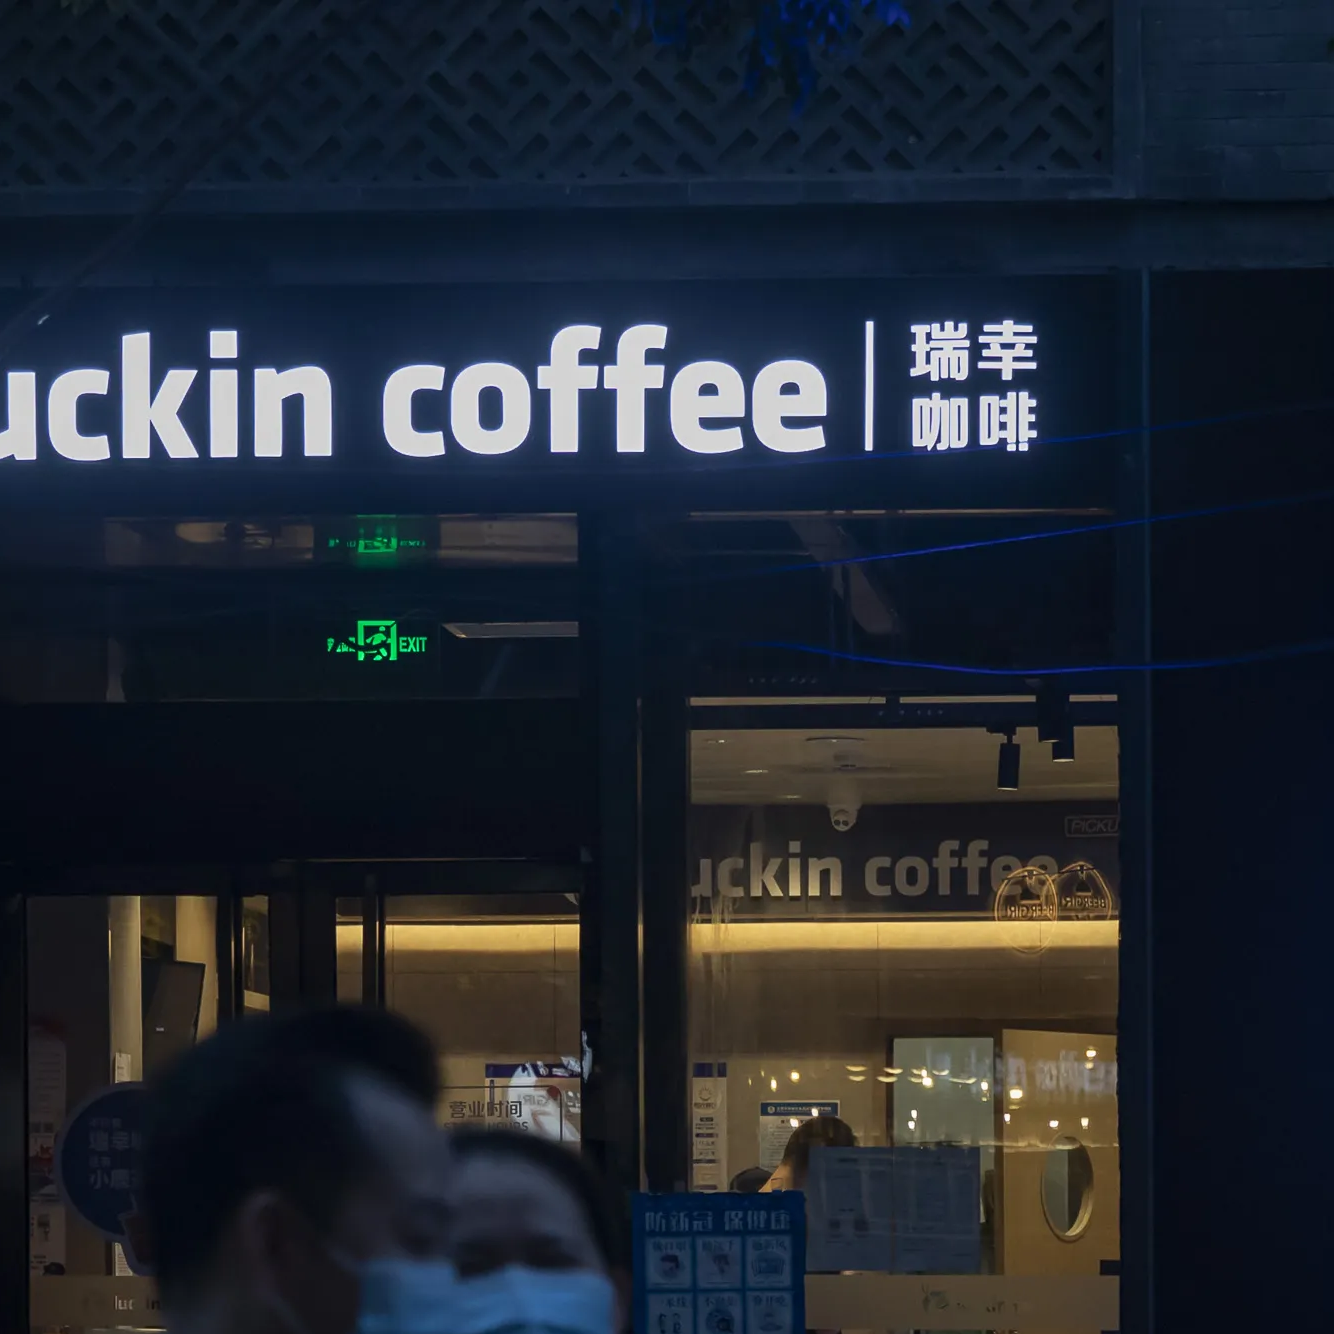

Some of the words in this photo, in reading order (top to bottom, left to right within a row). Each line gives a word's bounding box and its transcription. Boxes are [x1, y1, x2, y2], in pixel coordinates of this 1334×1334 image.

[910, 320, 1038, 382] 瑞幸
[382, 324, 828, 458] coffee
[911, 391, 1038, 452] 咖啡
[399, 636, 428, 652] EXIT
[1070, 818, 1119, 834] PICKU
[691, 839, 843, 899] uckin
[864, 839, 1058, 898] coffee
[448, 1101, 523, 1118] 营业时间
[644, 1210, 713, 1232] 防新冠
[724, 1209, 791, 1231] 保健康
